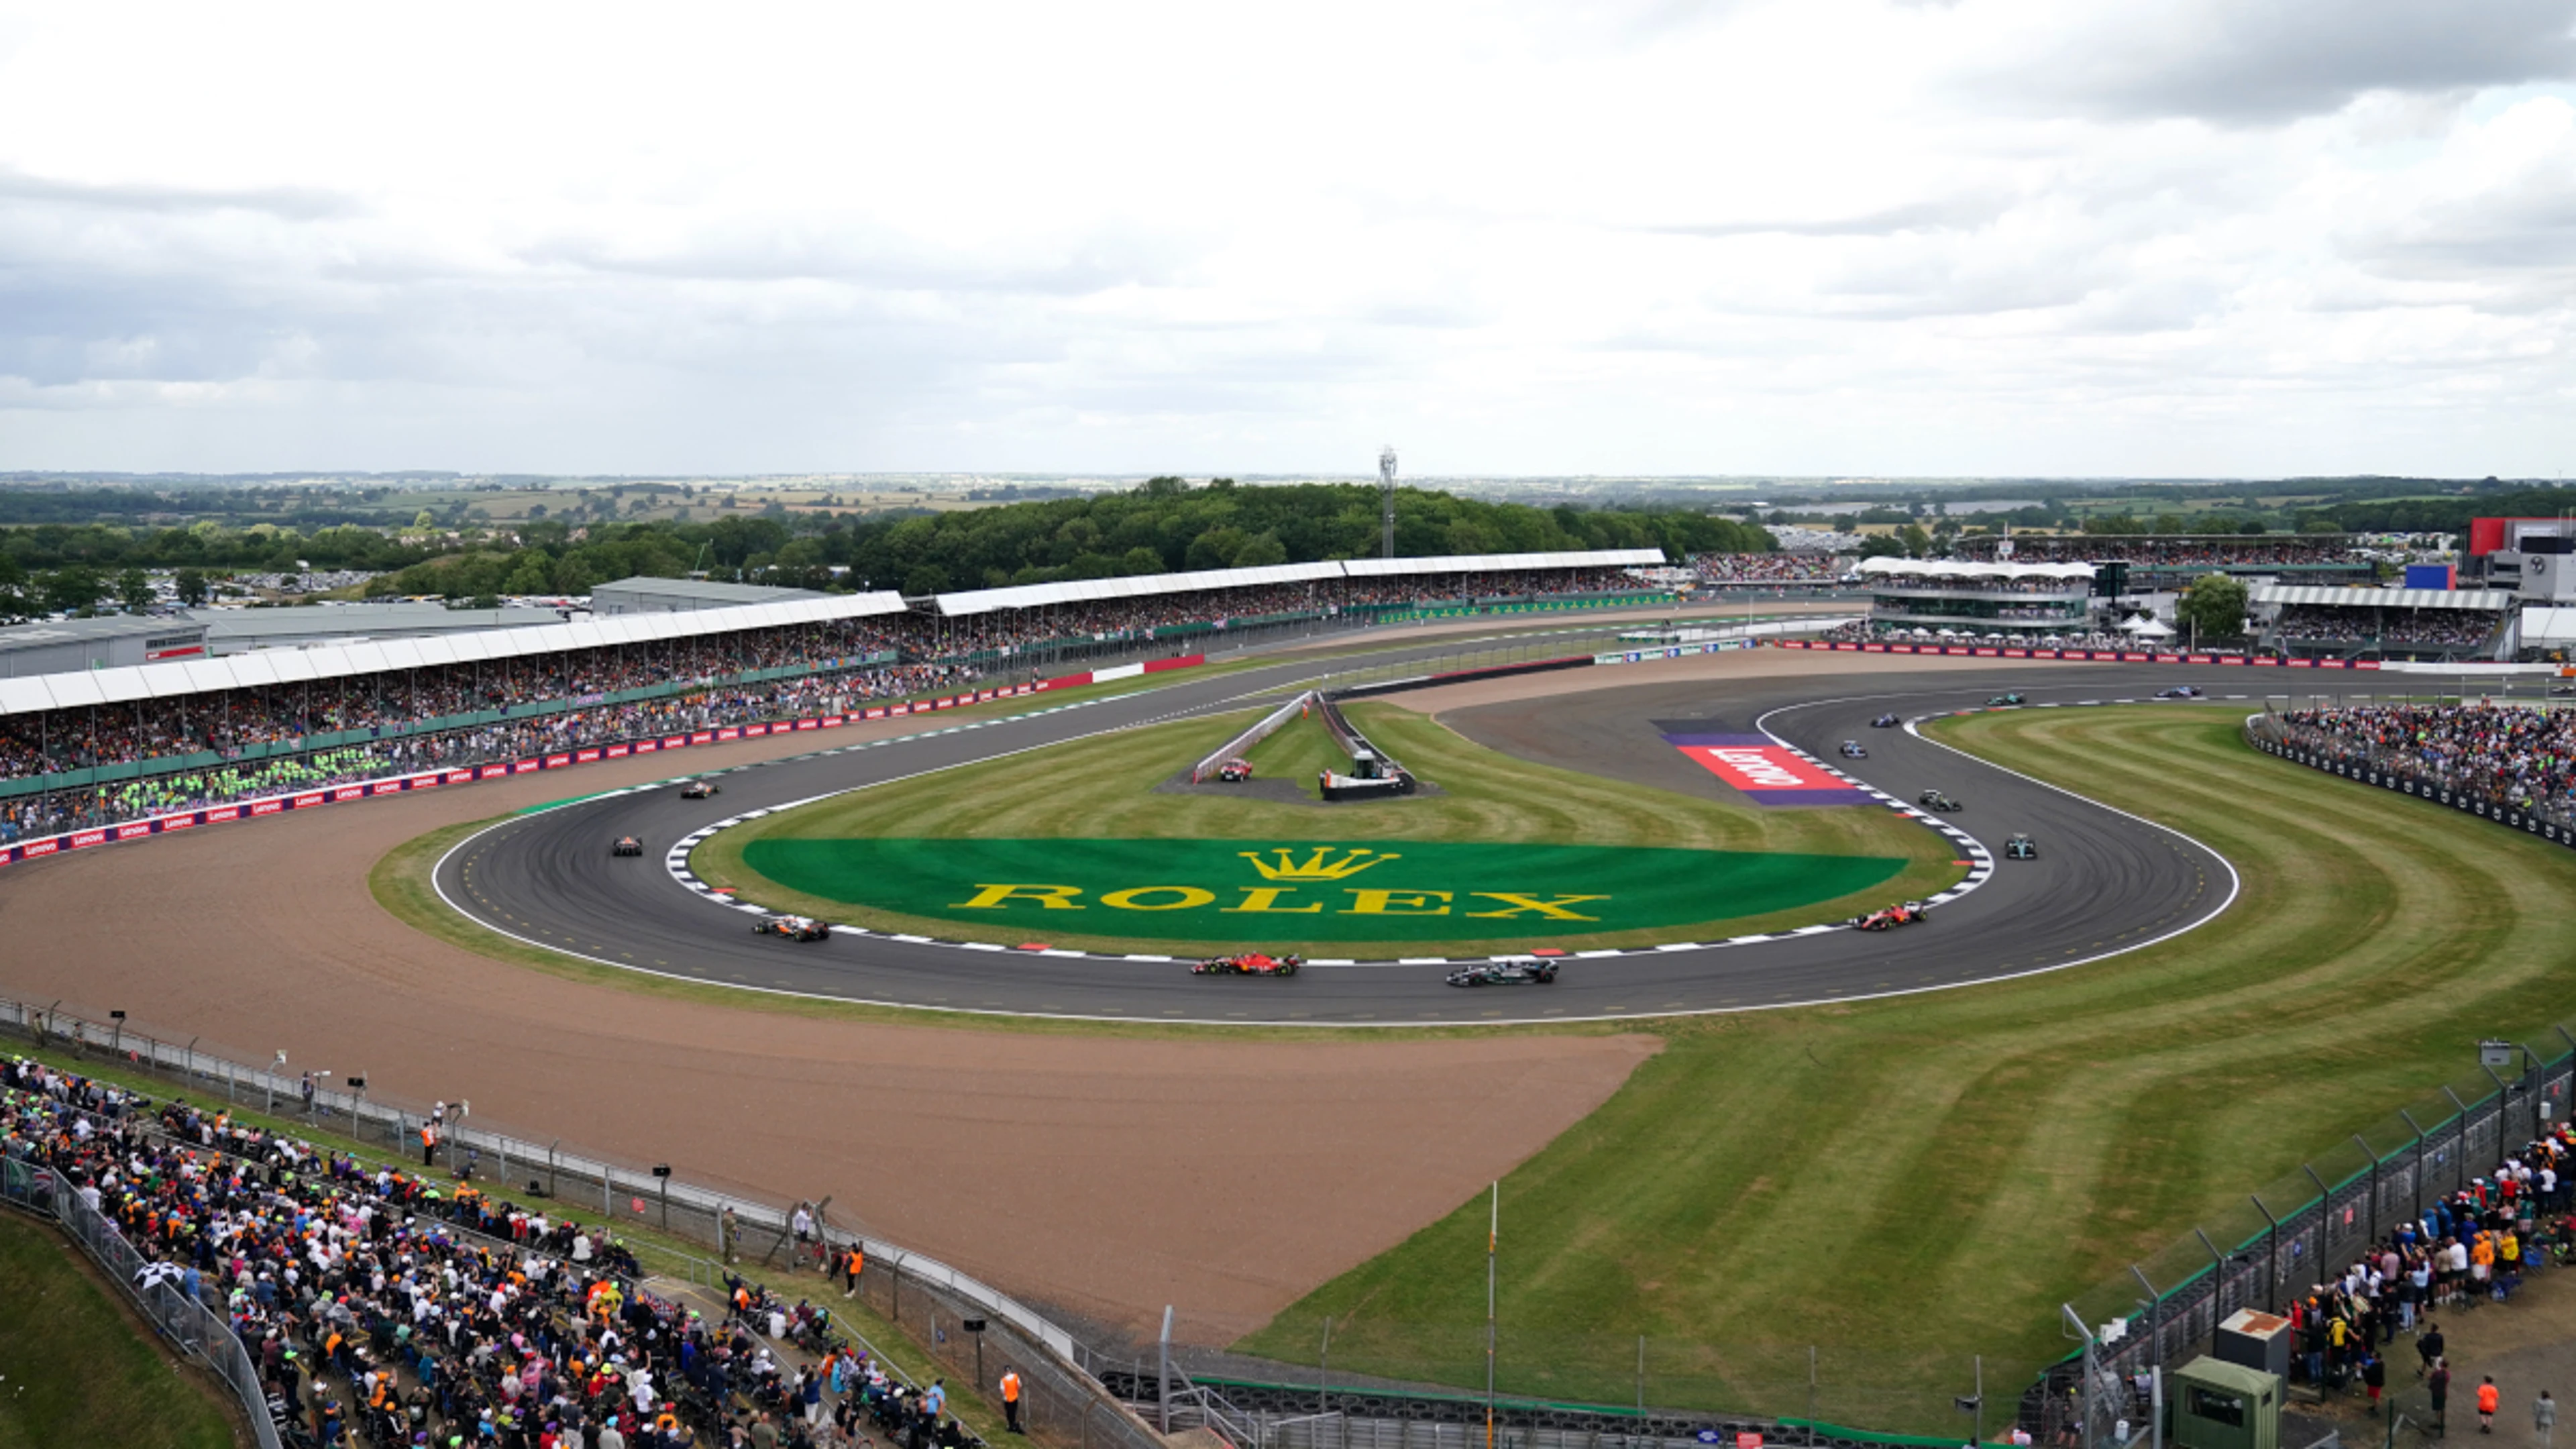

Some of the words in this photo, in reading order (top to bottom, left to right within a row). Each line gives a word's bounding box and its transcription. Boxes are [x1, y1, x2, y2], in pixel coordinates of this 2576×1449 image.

[1708, 749, 1804, 786] Lenovo
[336, 789, 362, 799] Lenovo
[296, 796, 323, 806] Lenovo
[253, 802, 280, 814] Lenovo
[209, 810, 237, 821] Lenovo
[164, 817, 192, 829] Lenovo
[119, 825, 149, 837] Lenovo
[74, 833, 104, 846] Lenovo
[25, 843, 56, 855] Lenovo
[948, 884, 1611, 921] ROLEX
